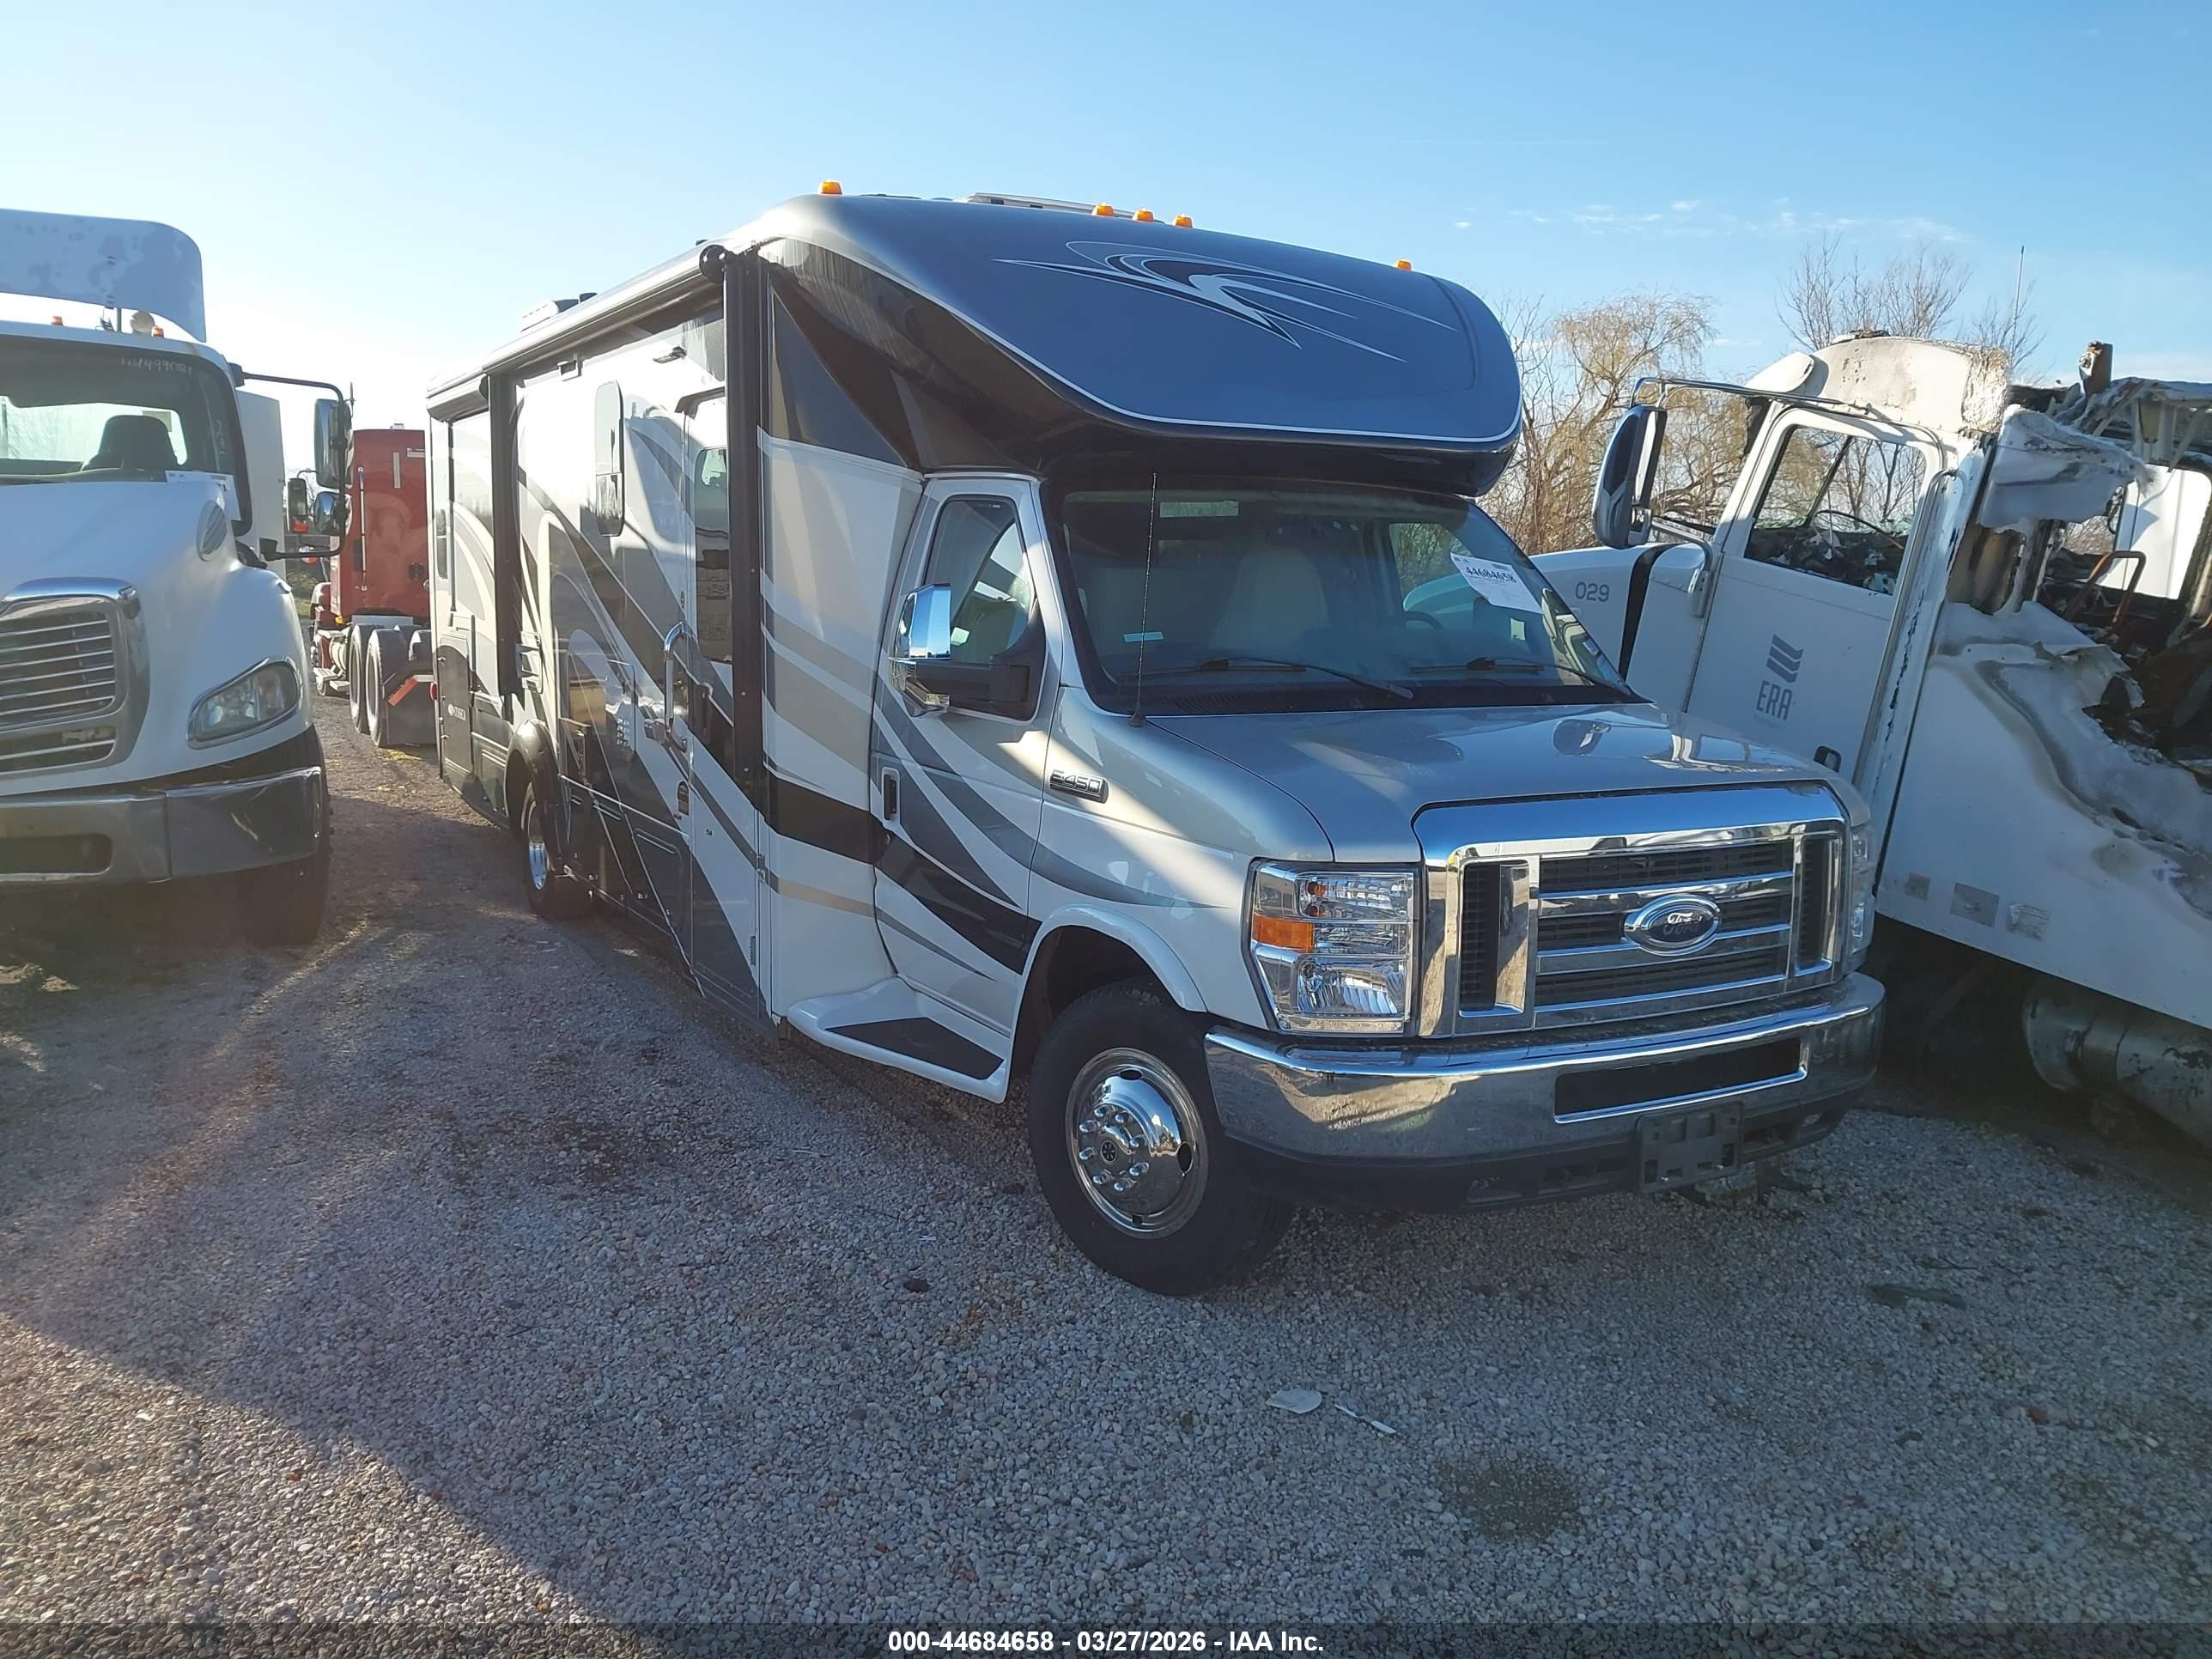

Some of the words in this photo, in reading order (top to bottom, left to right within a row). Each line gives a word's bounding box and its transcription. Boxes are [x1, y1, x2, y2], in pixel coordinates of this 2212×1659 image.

[1466, 567, 1517, 583] 44684658
[1576, 581, 1609, 602] 029
[1756, 680, 1792, 720] ERA
[1051, 769, 1101, 794] E-450
[1663, 912, 1704, 936] Ford
